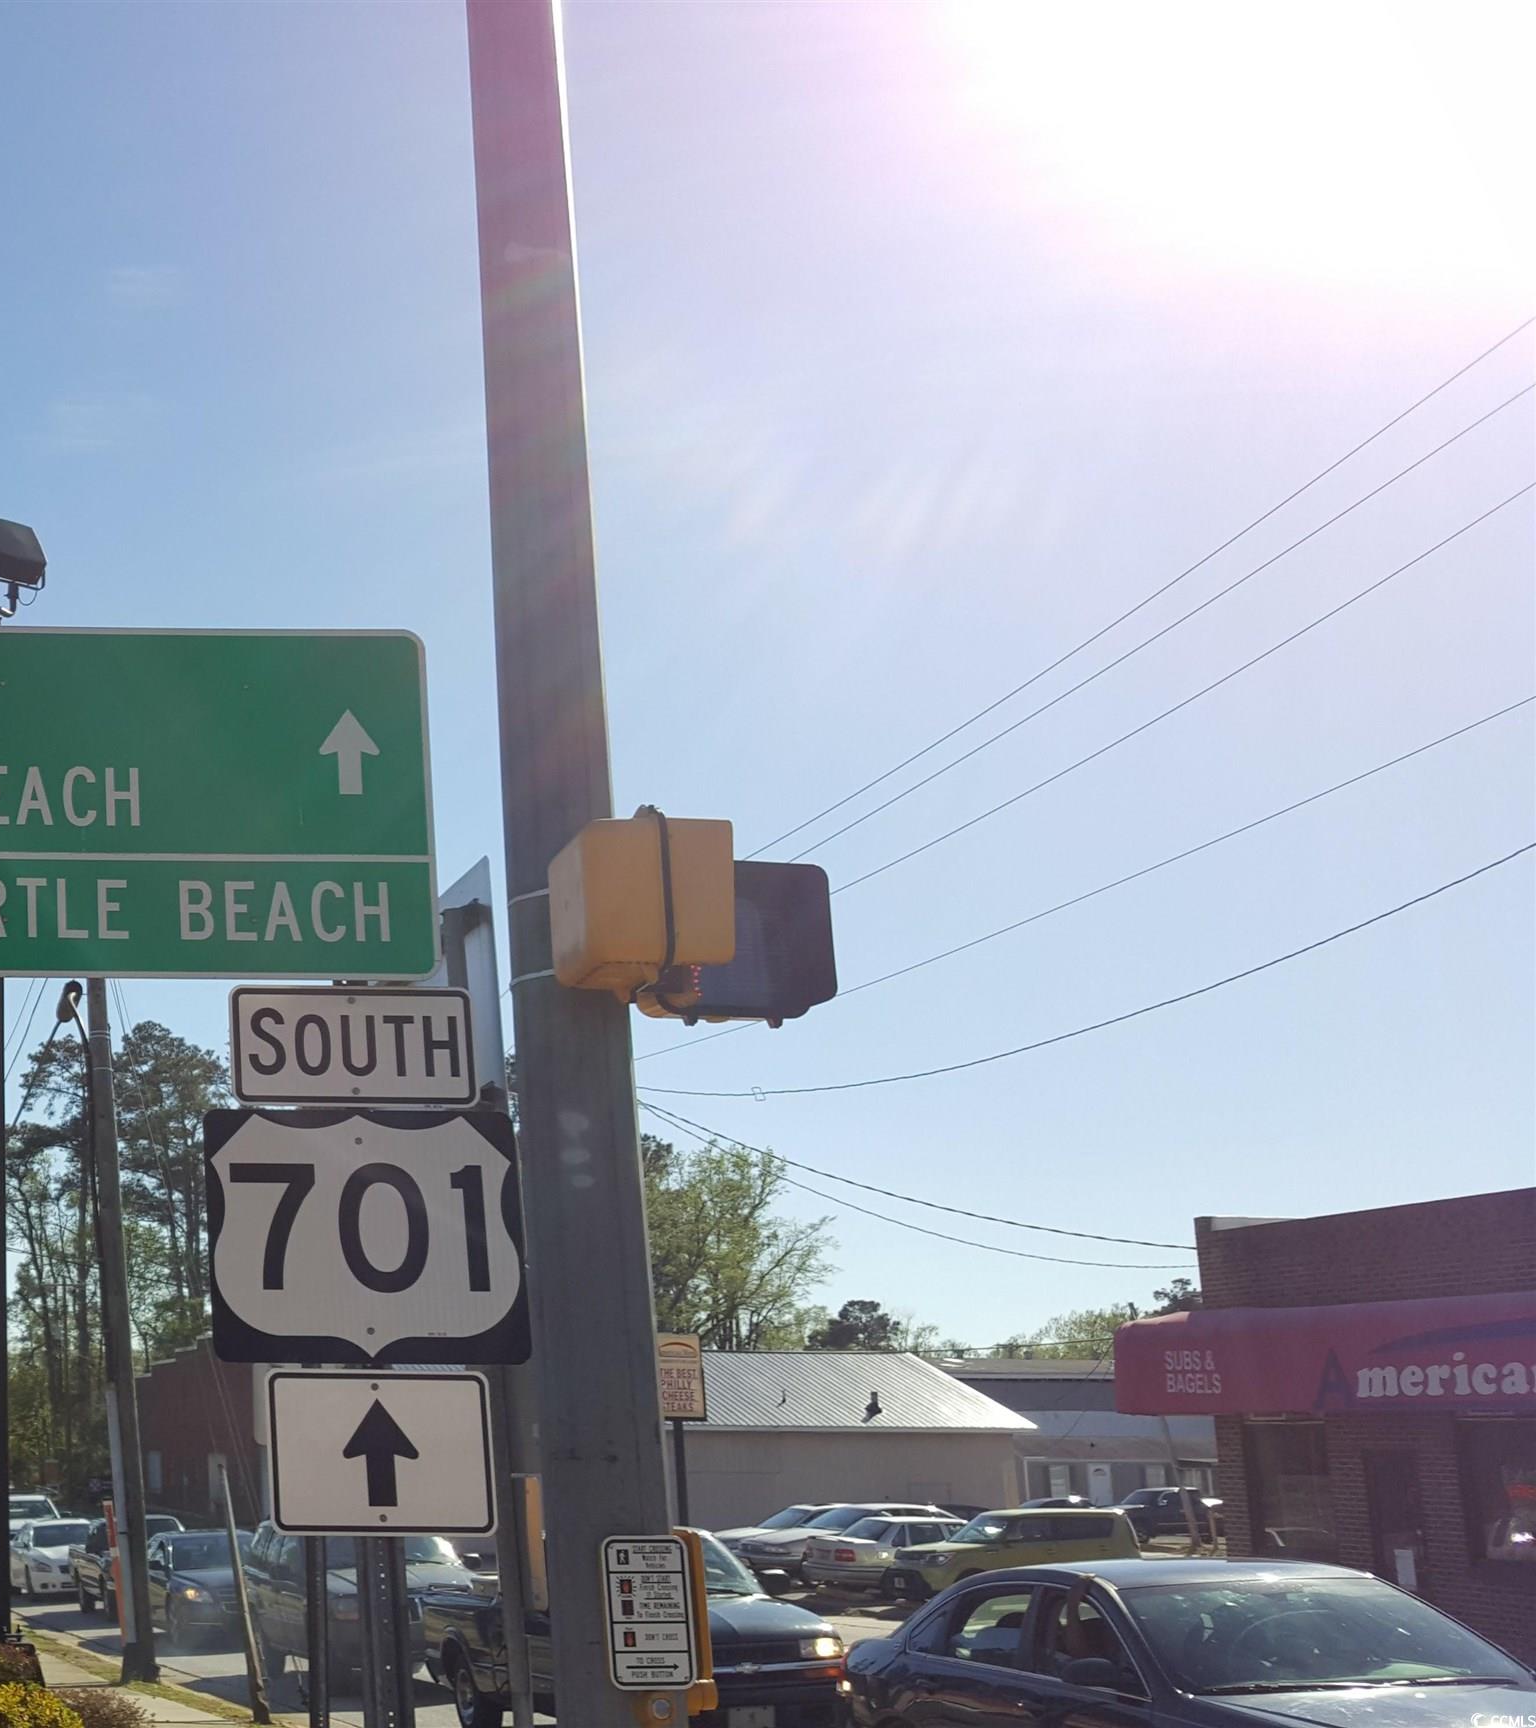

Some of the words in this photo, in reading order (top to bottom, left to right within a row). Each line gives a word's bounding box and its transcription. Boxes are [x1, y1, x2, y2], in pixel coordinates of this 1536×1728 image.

[178, 880, 392, 942] BEACH
[248, 1007, 461, 1078] SOUTH
[229, 1162, 491, 1294] 701
[1164, 1350, 1202, 1371] SUBS
[1205, 1350, 1216, 1371] &
[1167, 1373, 1222, 1394] BAGELS
[1313, 1347, 1536, 1410] America
